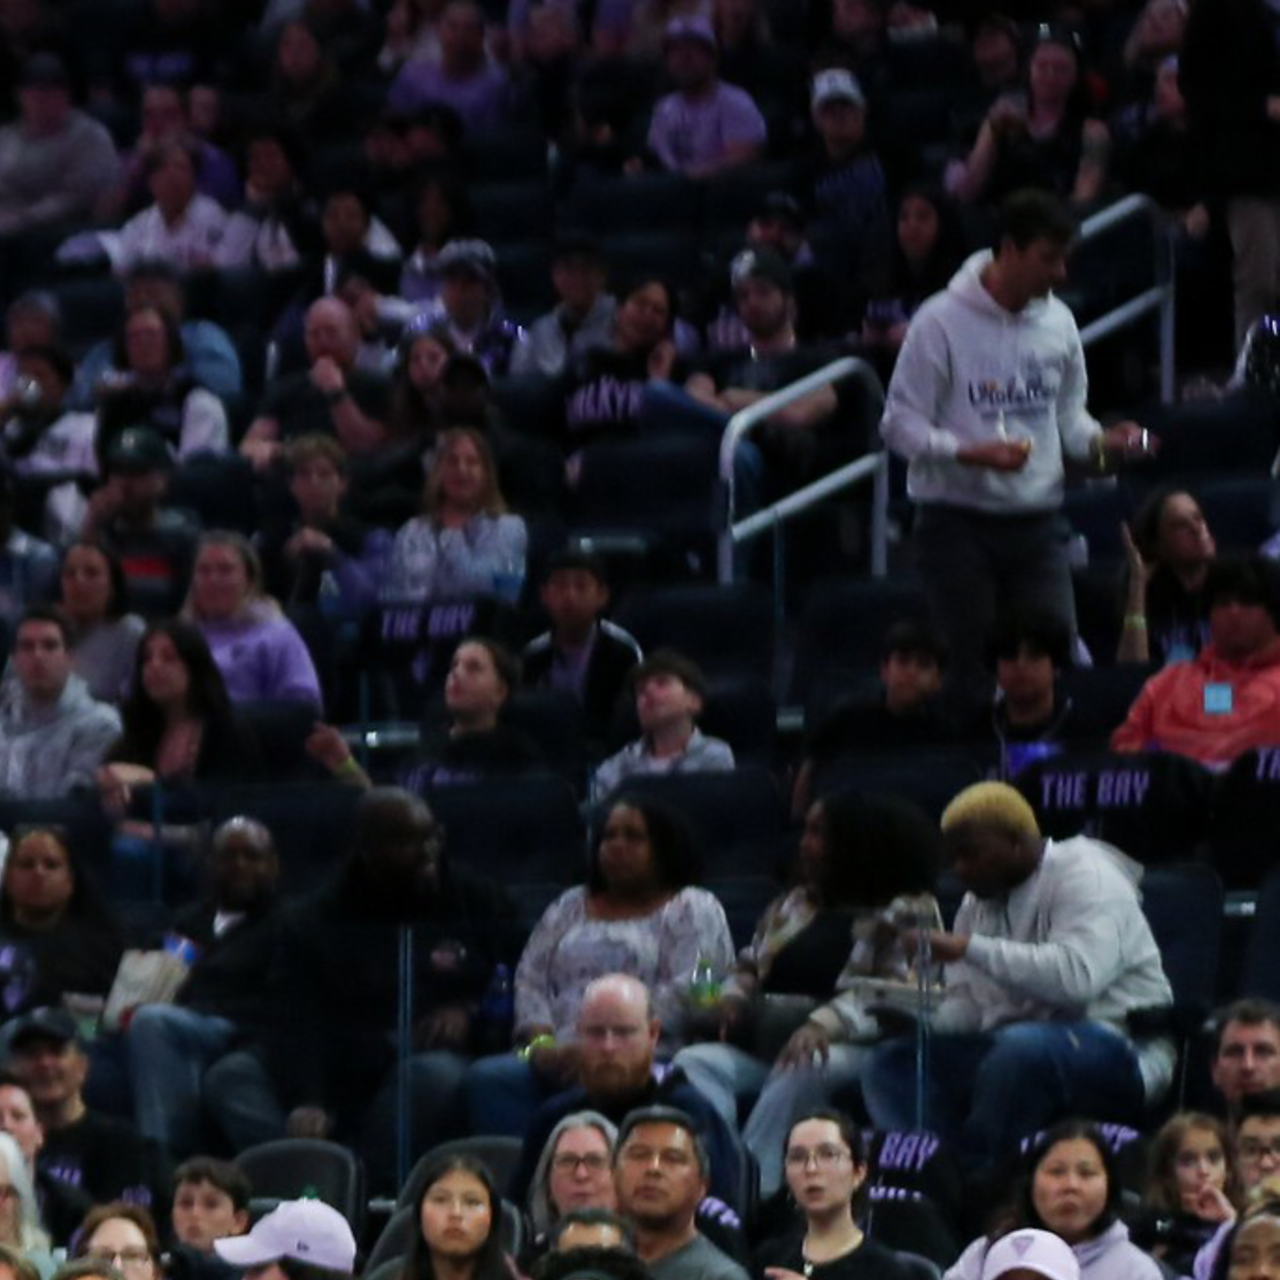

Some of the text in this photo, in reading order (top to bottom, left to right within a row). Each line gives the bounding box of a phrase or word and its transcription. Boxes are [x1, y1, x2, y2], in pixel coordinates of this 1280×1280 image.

[1040, 769, 1150, 809] THE BAY
[878, 1130, 939, 1171] BAY
